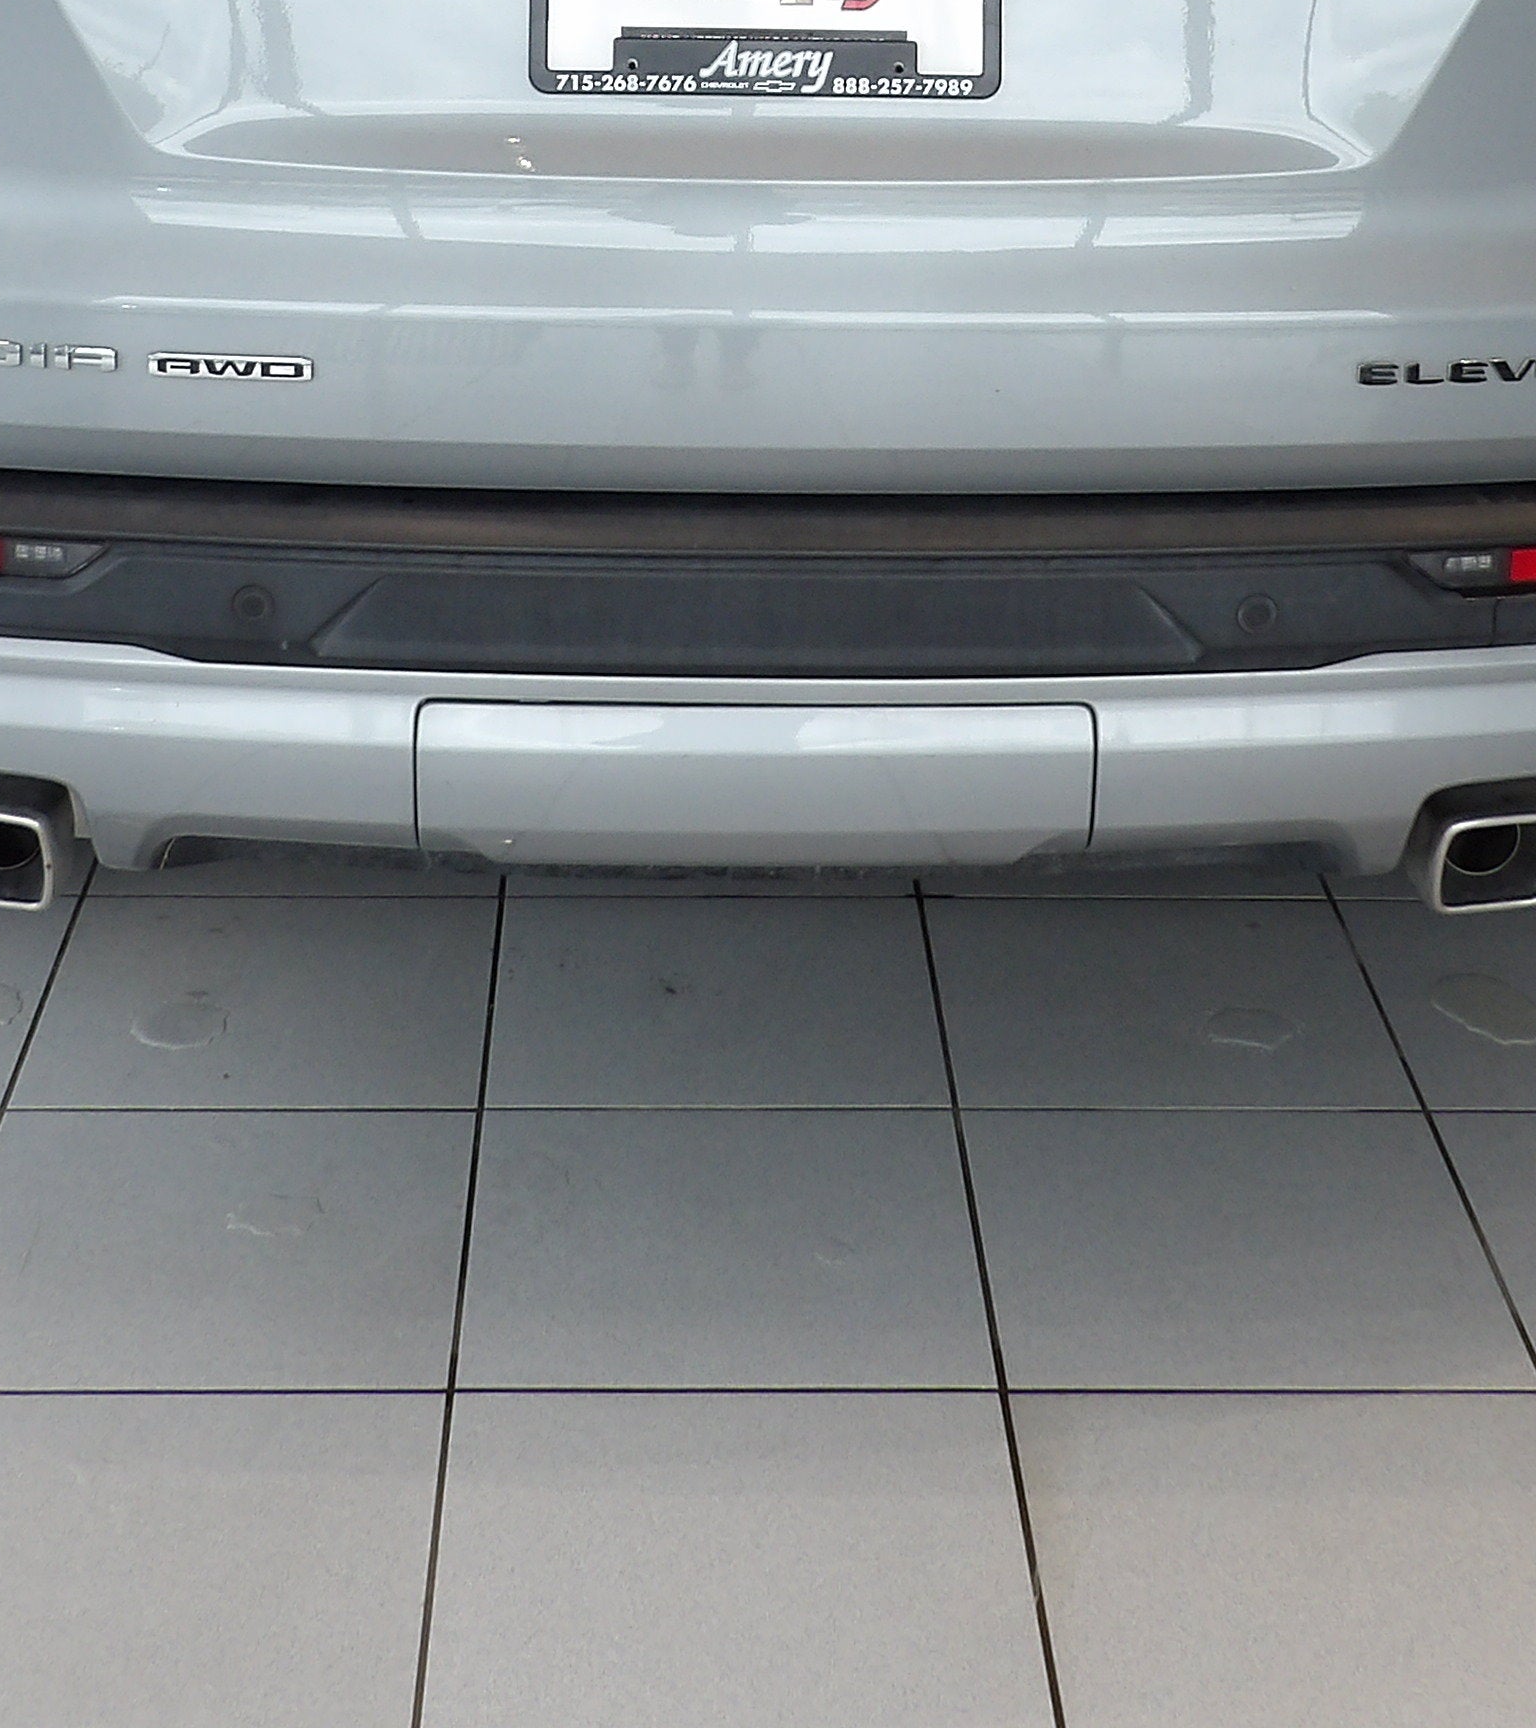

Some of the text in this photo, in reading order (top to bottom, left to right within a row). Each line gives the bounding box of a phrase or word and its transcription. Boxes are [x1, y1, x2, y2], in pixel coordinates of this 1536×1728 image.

[699, 40, 834, 94] Amery
[555, 74, 697, 94] 715-268-7676
[831, 77, 974, 98] 888-257-7989
[155, 355, 308, 380] AWD
